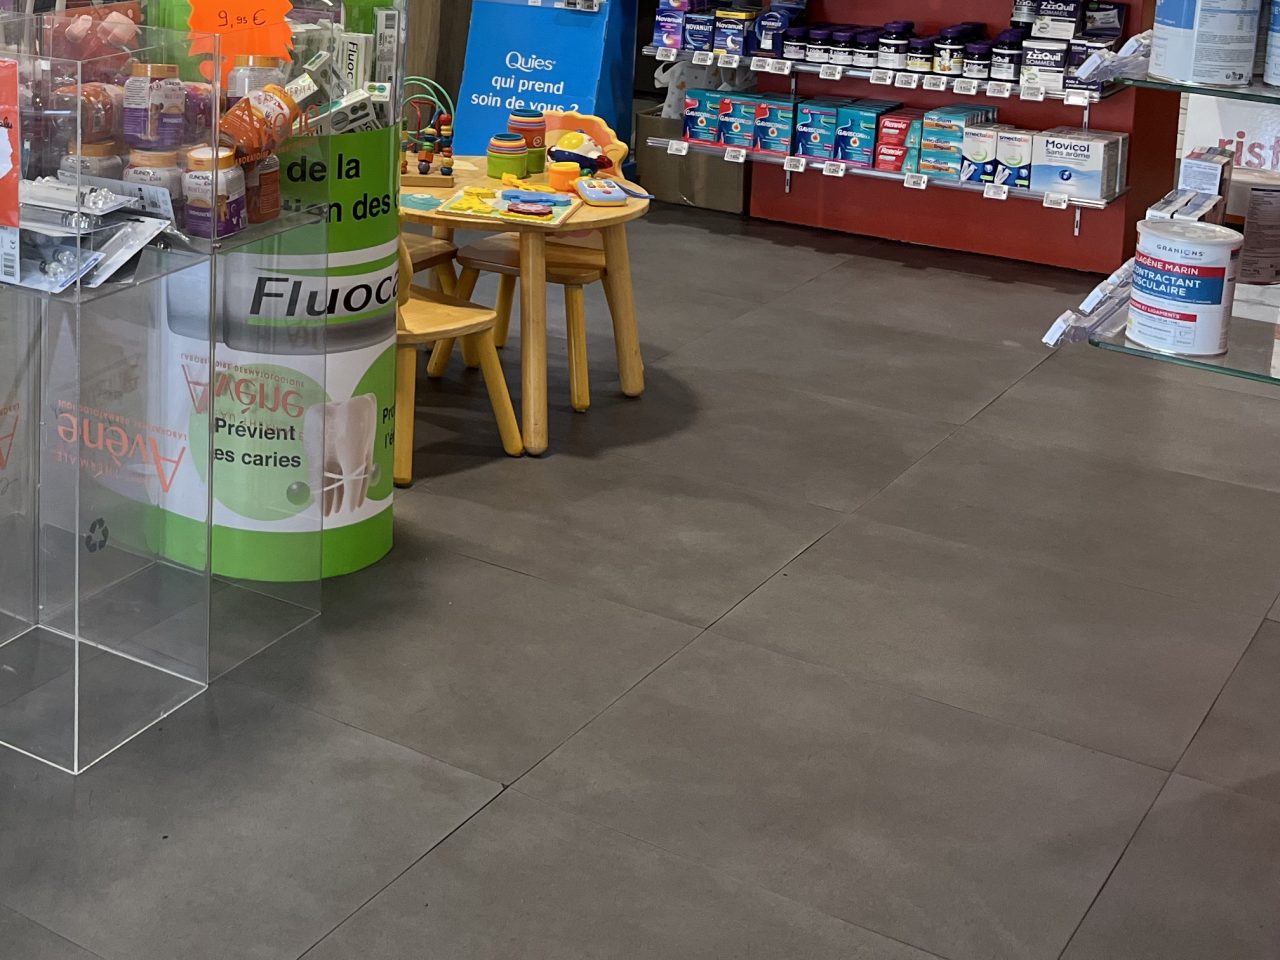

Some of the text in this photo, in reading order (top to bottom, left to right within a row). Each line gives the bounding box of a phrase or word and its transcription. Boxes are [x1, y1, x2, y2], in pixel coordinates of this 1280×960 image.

[1039, 8, 1068, 17] SOMMEIL
[1040, 0, 1076, 12] ZzzQuil
[686, 23, 712, 32] NOVANUIT
[505, 51, 556, 72] Quies
[1026, 49, 1063, 61] ZzzQuil
[1026, 59, 1056, 67] SOMMEIL
[491, 75, 564, 95] qui prend
[471, 93, 501, 108] soin
[505, 94, 525, 110] de
[529, 98, 564, 112] vous
[884, 120, 907, 129] Rennie
[880, 147, 903, 156] Rennie
[1046, 139, 1090, 152] Movicol
[1065, 151, 1090, 159] arôme
[287, 153, 360, 182] de la
[352, 193, 390, 220] des
[1156, 244, 1204, 257] GRANIONS
[215, 417, 296, 441] Prévient
[214, 448, 302, 468] es caries
